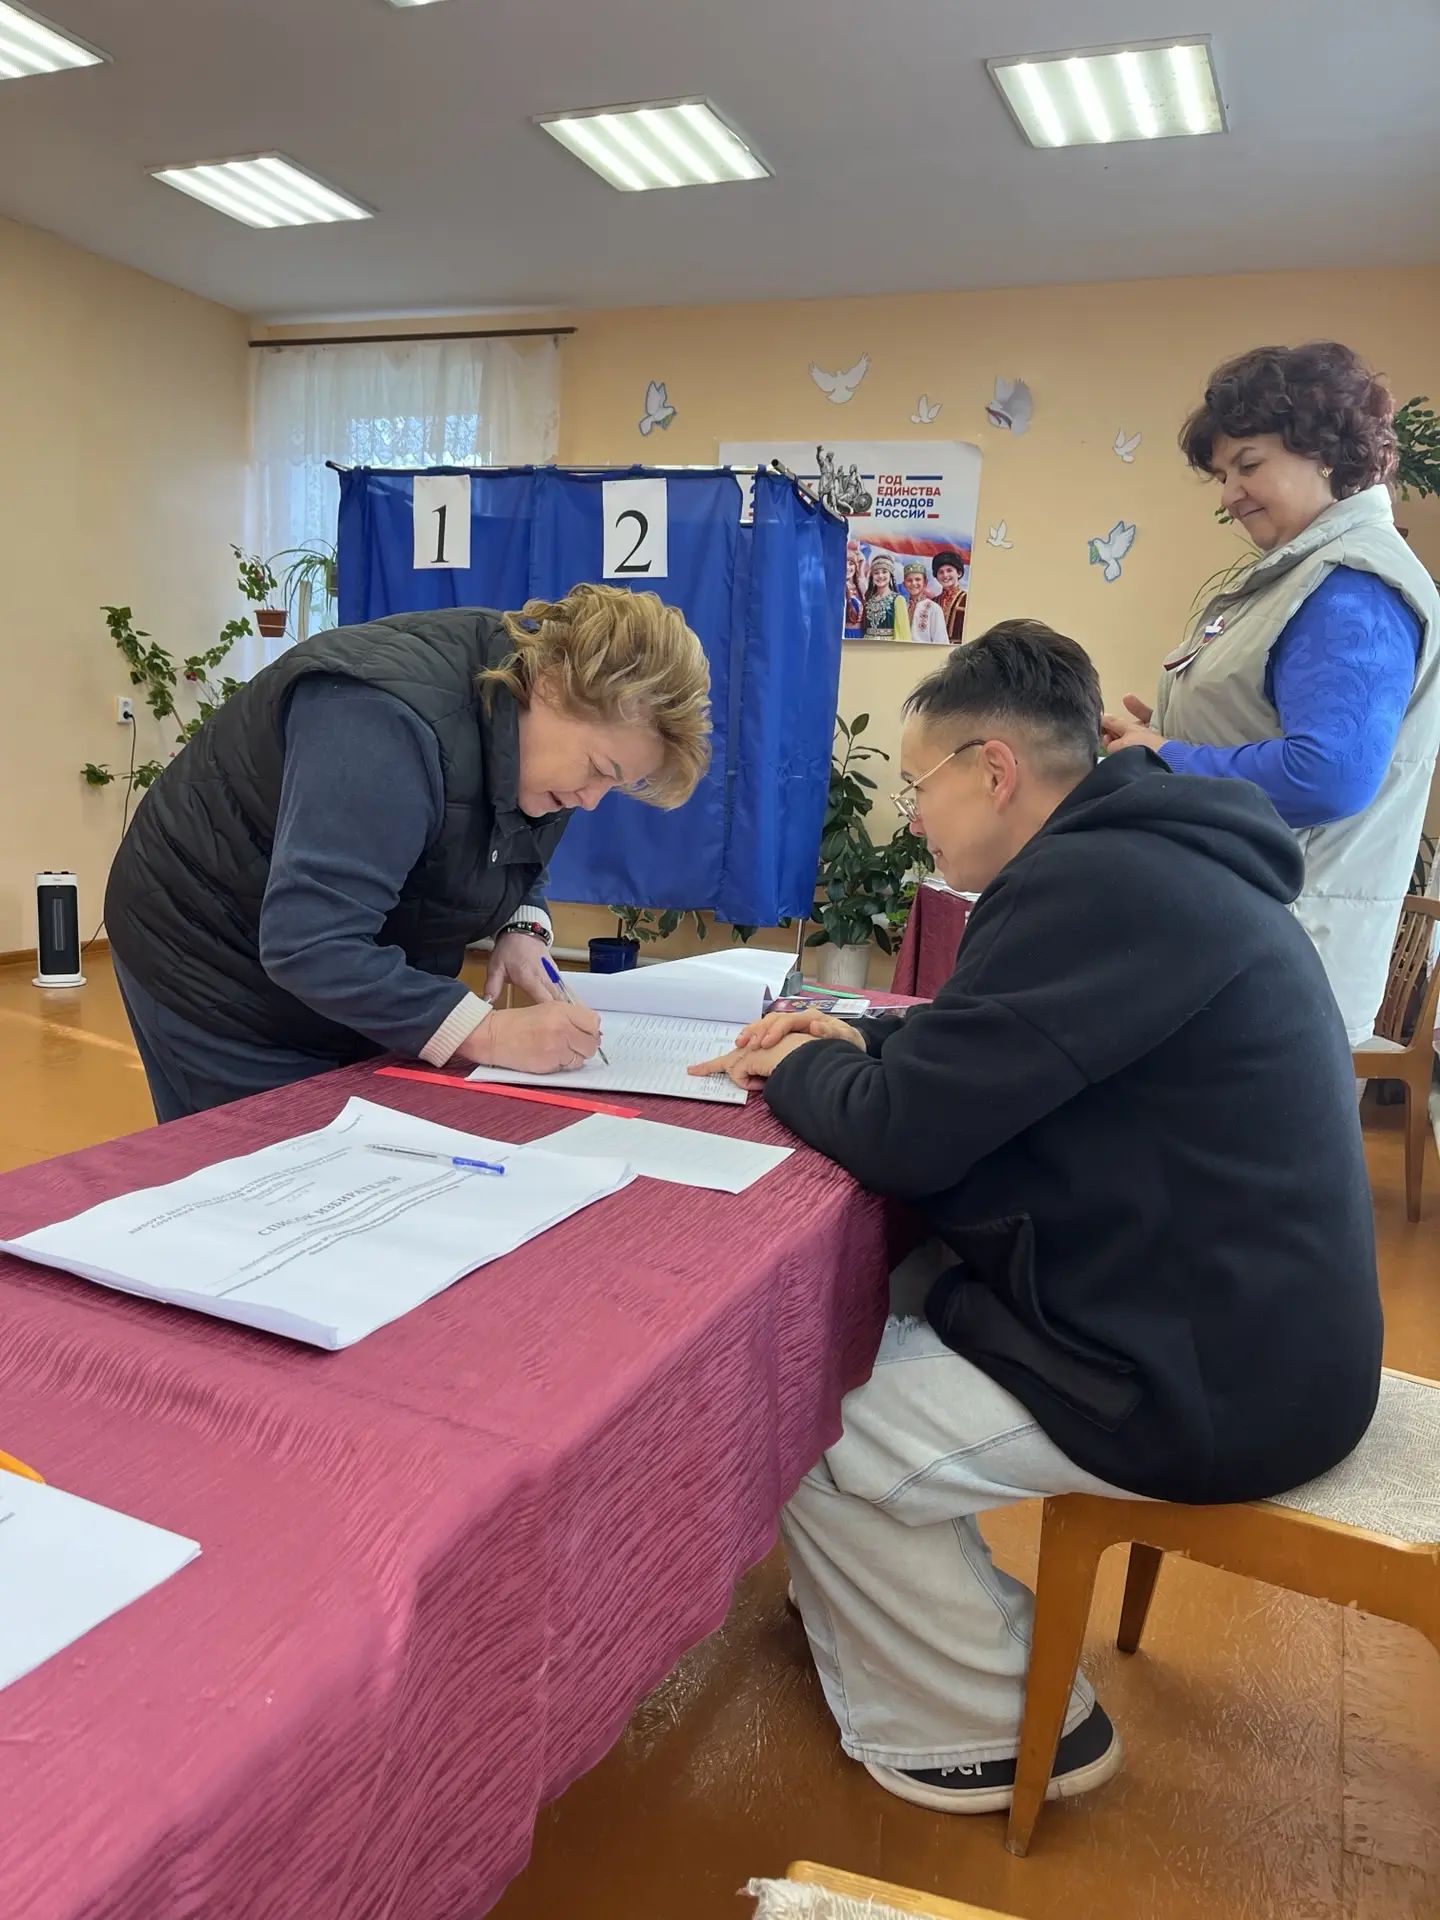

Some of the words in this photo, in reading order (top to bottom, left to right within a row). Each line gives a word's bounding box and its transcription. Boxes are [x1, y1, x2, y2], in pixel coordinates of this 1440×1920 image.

[878, 475, 902, 486] ГОД
[877, 486, 941, 497] ЕДИНСТВА
[876, 497, 934, 508] НАРОДОВ
[875, 508, 925, 519] РОССИИ
[430, 504, 449, 564] 1
[614, 509, 653, 573] 2
